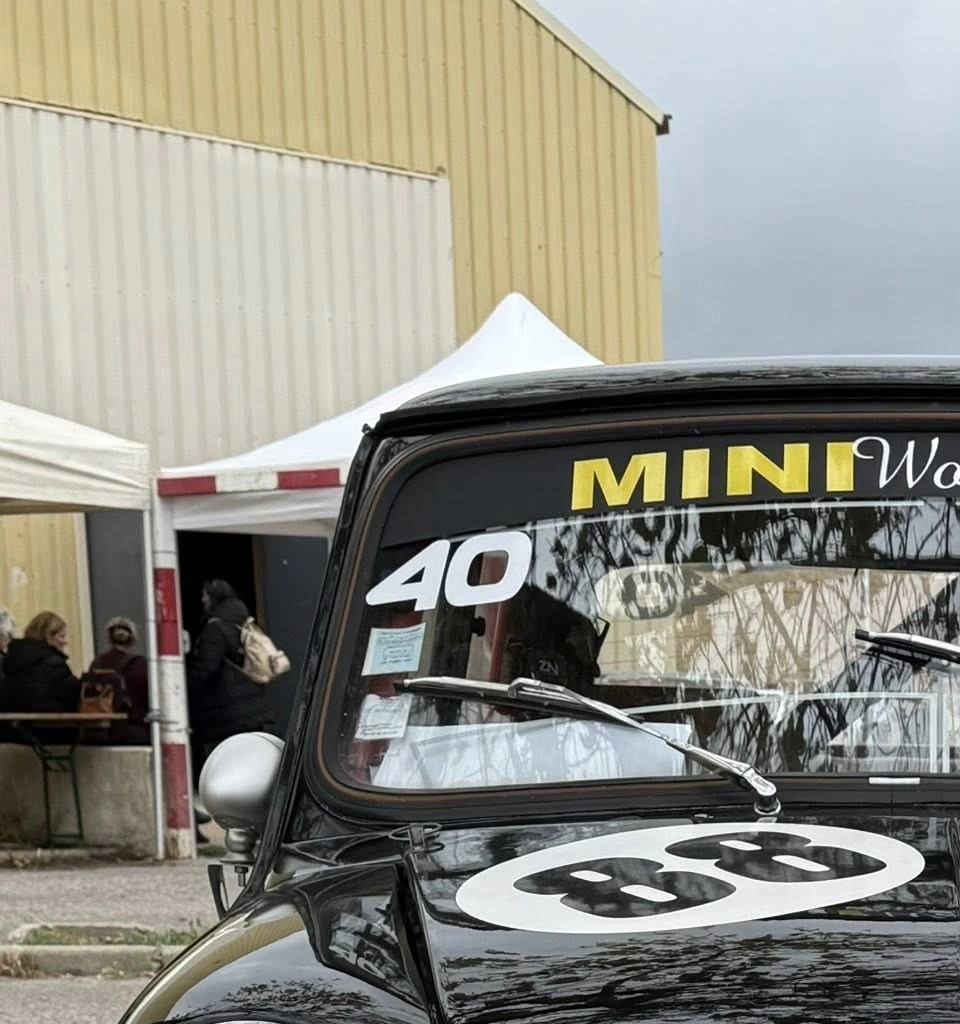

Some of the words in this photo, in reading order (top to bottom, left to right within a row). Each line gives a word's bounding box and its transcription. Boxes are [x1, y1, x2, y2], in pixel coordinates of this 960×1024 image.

[571, 442, 855, 510] MINI
[366, 531, 533, 611] 40
[513, 831, 887, 918] 88
